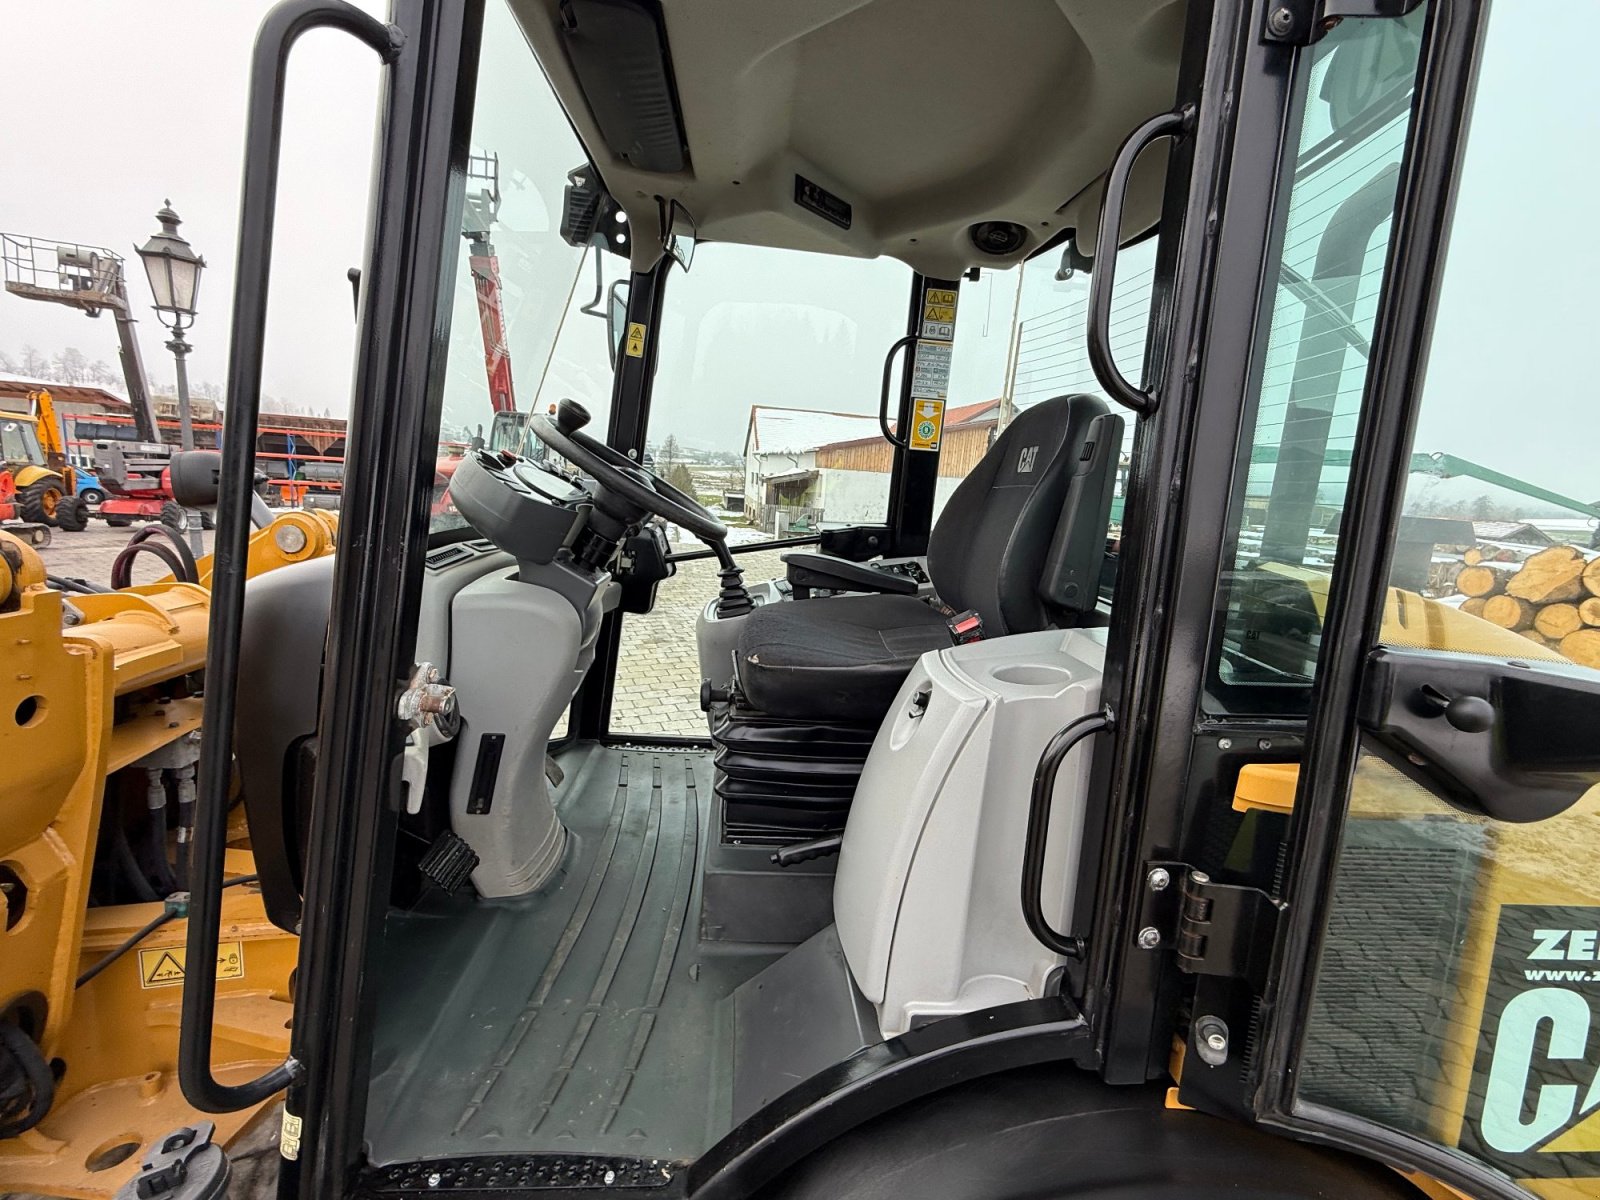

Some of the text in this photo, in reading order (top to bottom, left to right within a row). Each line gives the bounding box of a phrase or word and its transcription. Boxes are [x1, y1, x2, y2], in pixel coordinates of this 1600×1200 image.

[1017, 446, 1039, 473] CAT
[1526, 929, 1600, 960] ZE
[1481, 987, 1600, 1152] C
